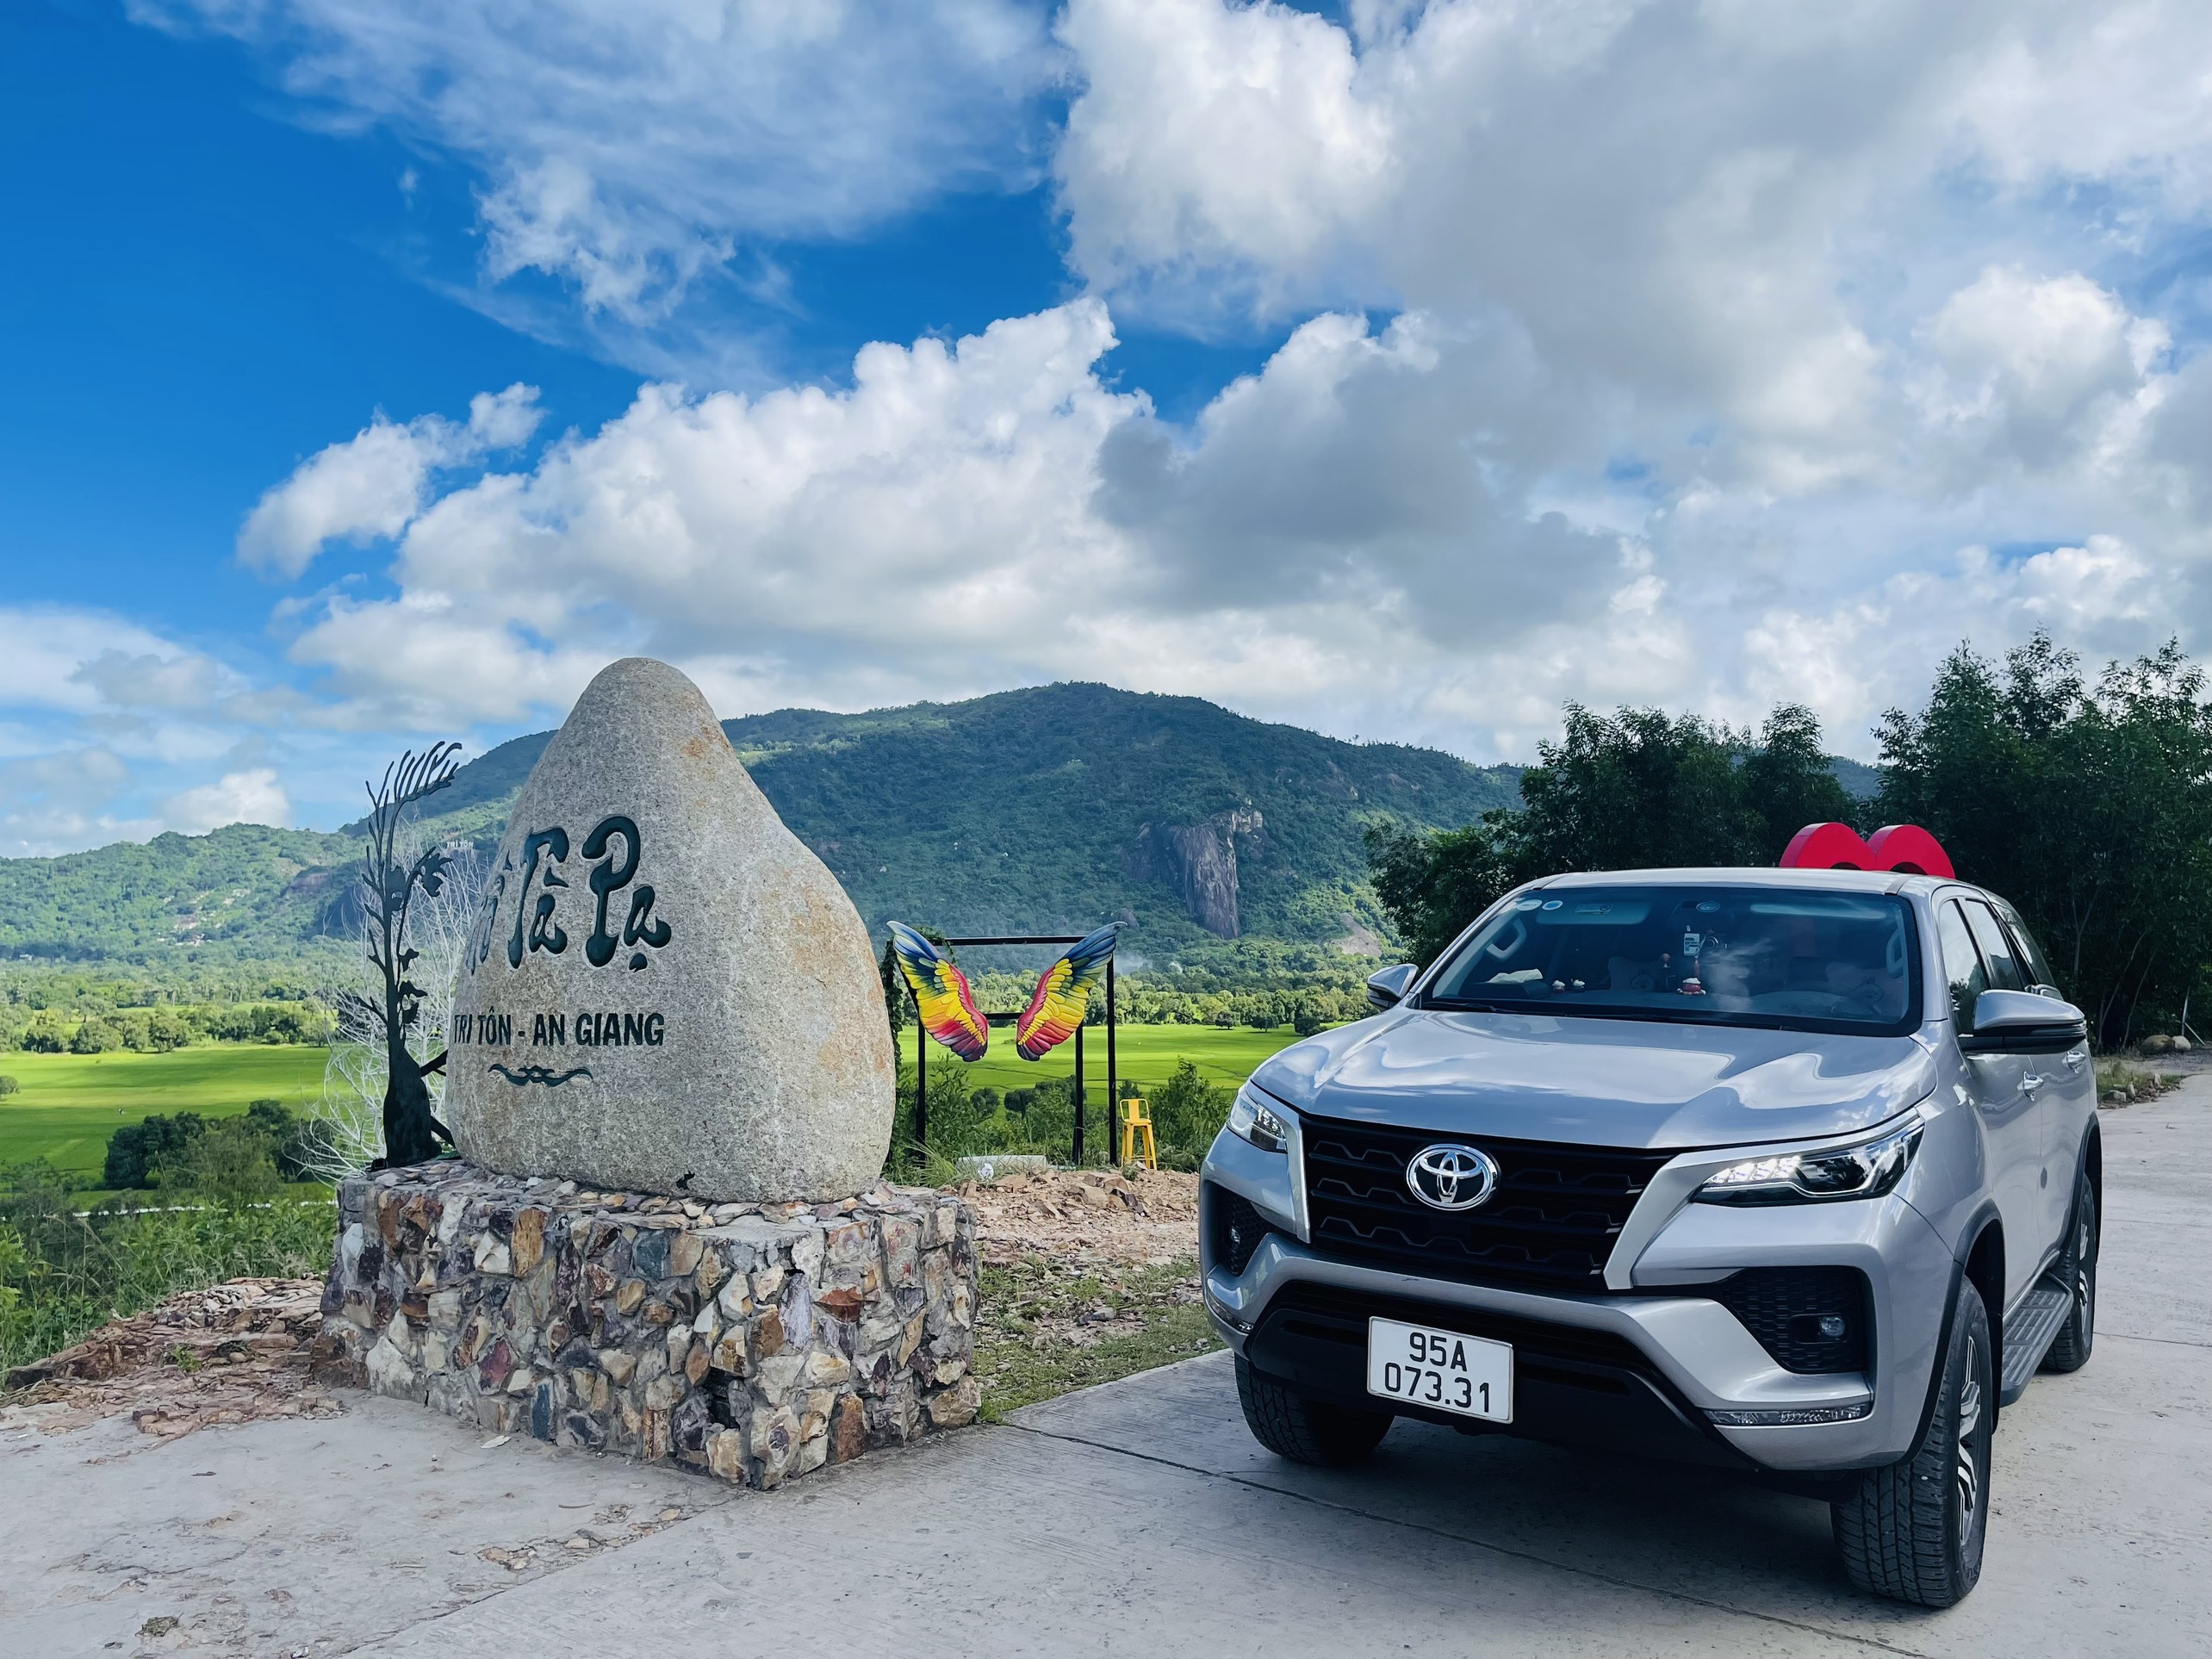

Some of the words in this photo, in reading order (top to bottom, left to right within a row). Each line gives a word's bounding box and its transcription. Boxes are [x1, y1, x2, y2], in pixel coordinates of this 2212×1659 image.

[581, 815, 672, 973] Pạ
[454, 1013, 473, 1045] TRI
[477, 1005, 512, 1047] TÔN
[532, 1013, 565, 1047] AN
[575, 1012, 665, 1047] GIANG
[1409, 1332, 1468, 1372] 95A
[1384, 1362, 1489, 1414] 073.31
